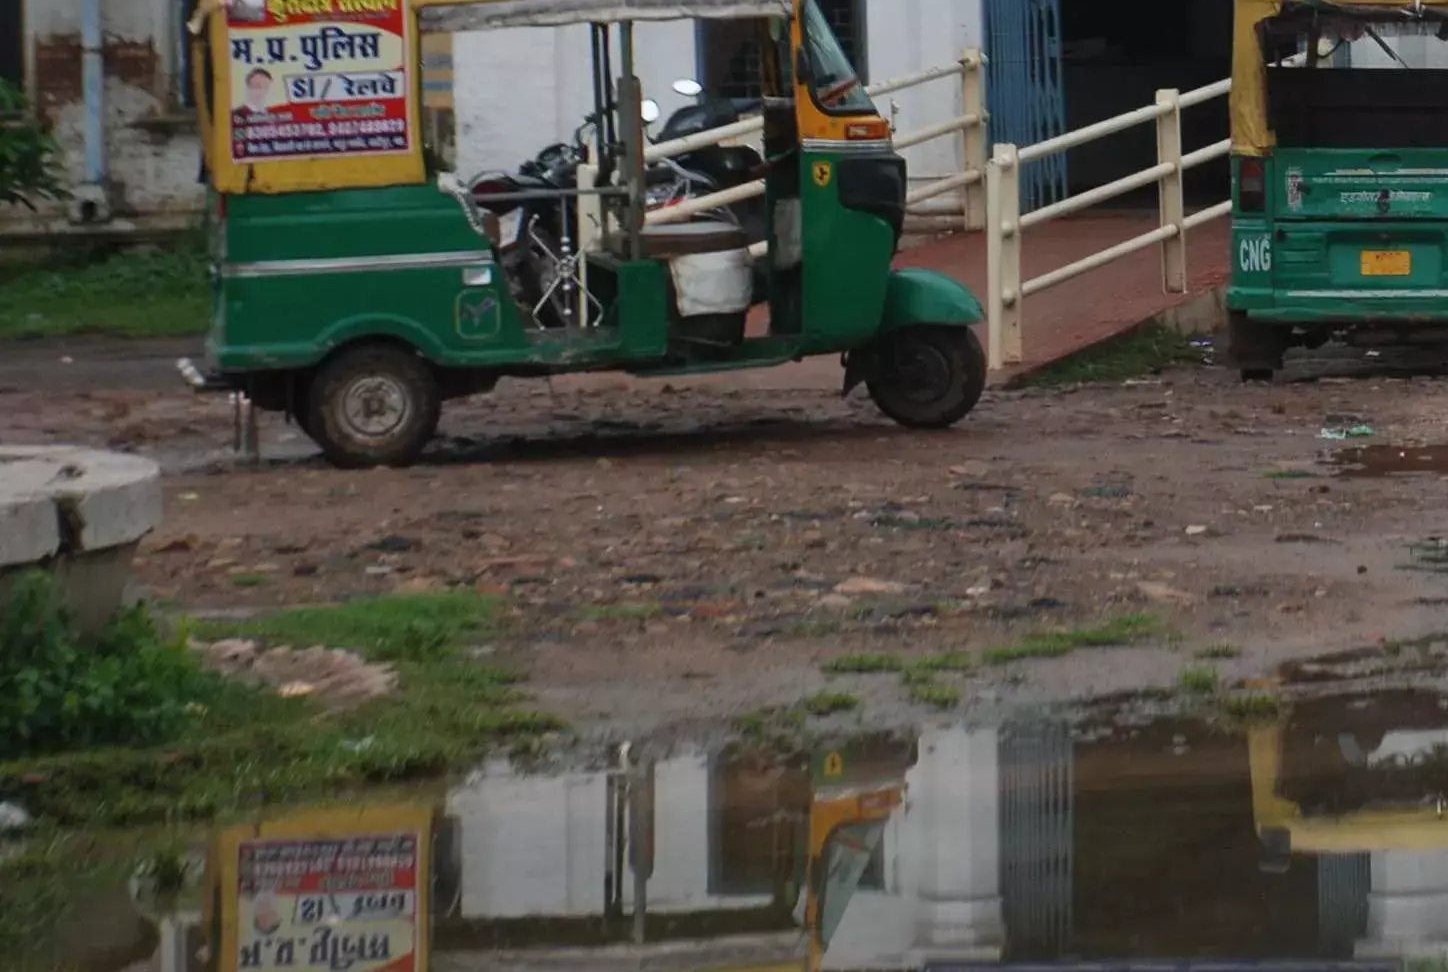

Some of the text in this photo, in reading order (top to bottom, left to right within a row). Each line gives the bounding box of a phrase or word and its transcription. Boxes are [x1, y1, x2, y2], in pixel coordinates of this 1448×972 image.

[292, 78, 314, 99] SI
[344, 75, 397, 97] रेलवे
[1240, 238, 1271, 272] CNG
